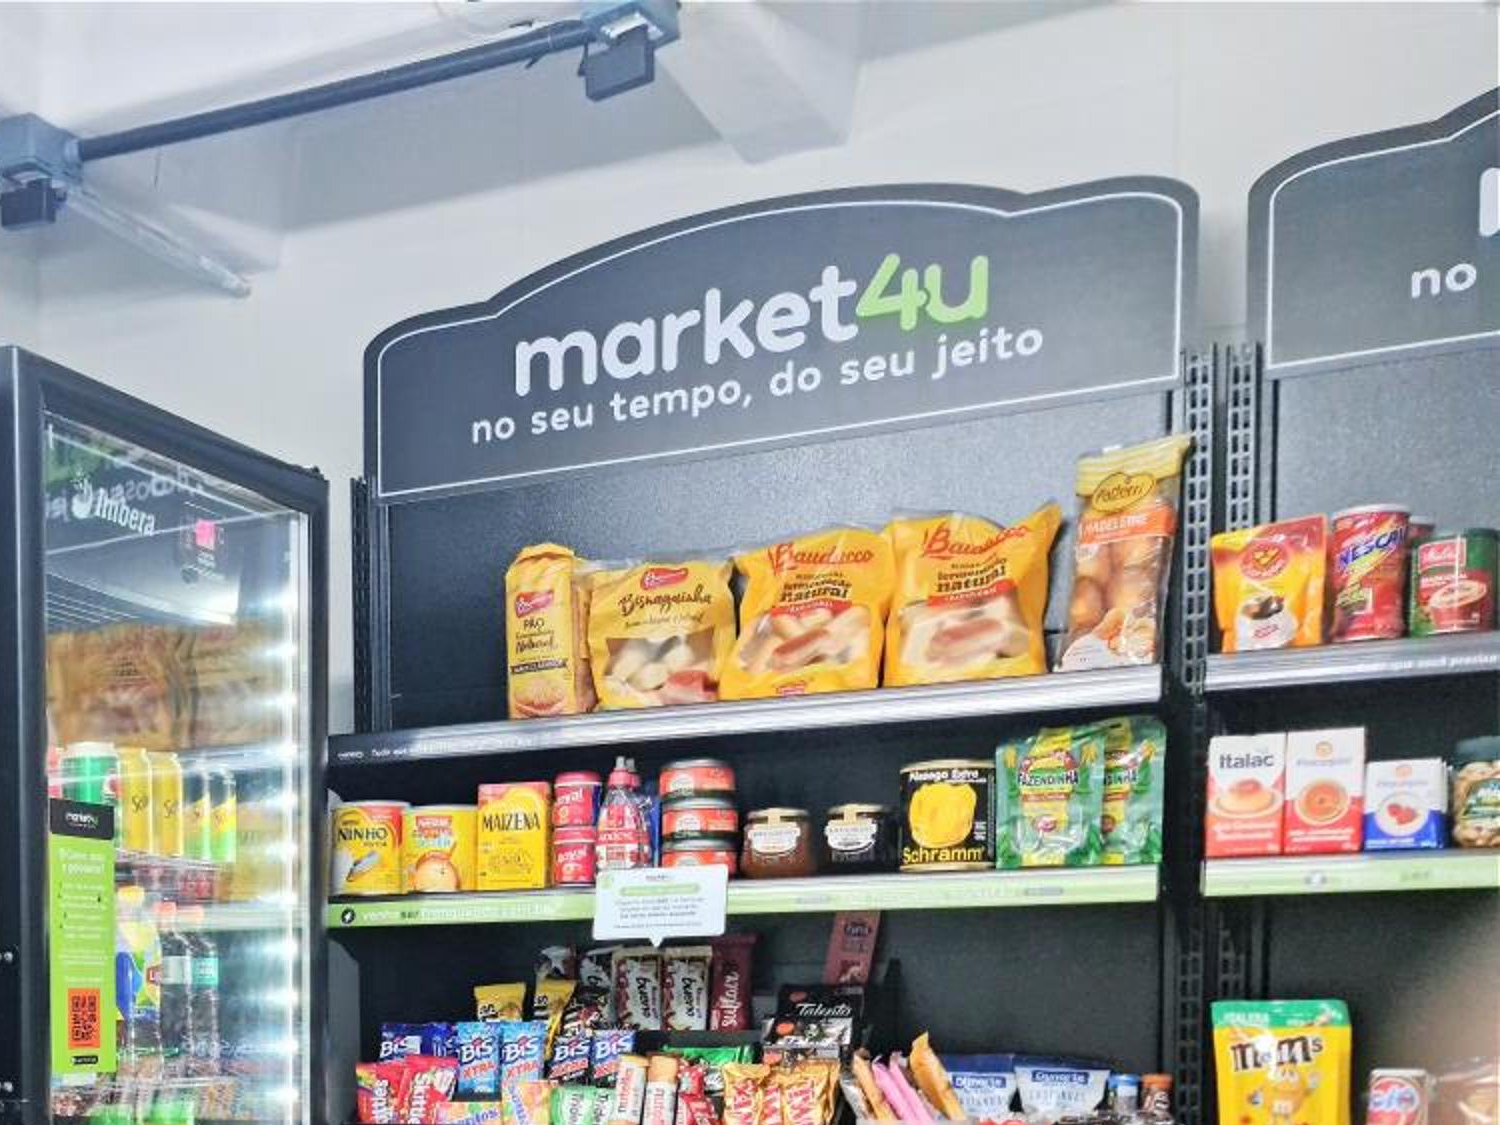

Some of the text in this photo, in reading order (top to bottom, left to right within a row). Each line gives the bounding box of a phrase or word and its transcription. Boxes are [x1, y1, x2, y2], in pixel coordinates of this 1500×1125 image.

[1410, 262, 1477, 299] no
[515, 253, 988, 395] market4u
[471, 323, 1044, 445] no seu tempo, do seu jeito
[1219, 752, 1275, 770] Italac
[481, 809, 541, 832] MAIZENA
[337, 826, 388, 841] NINHO
[797, 1000, 852, 1019] Talento
